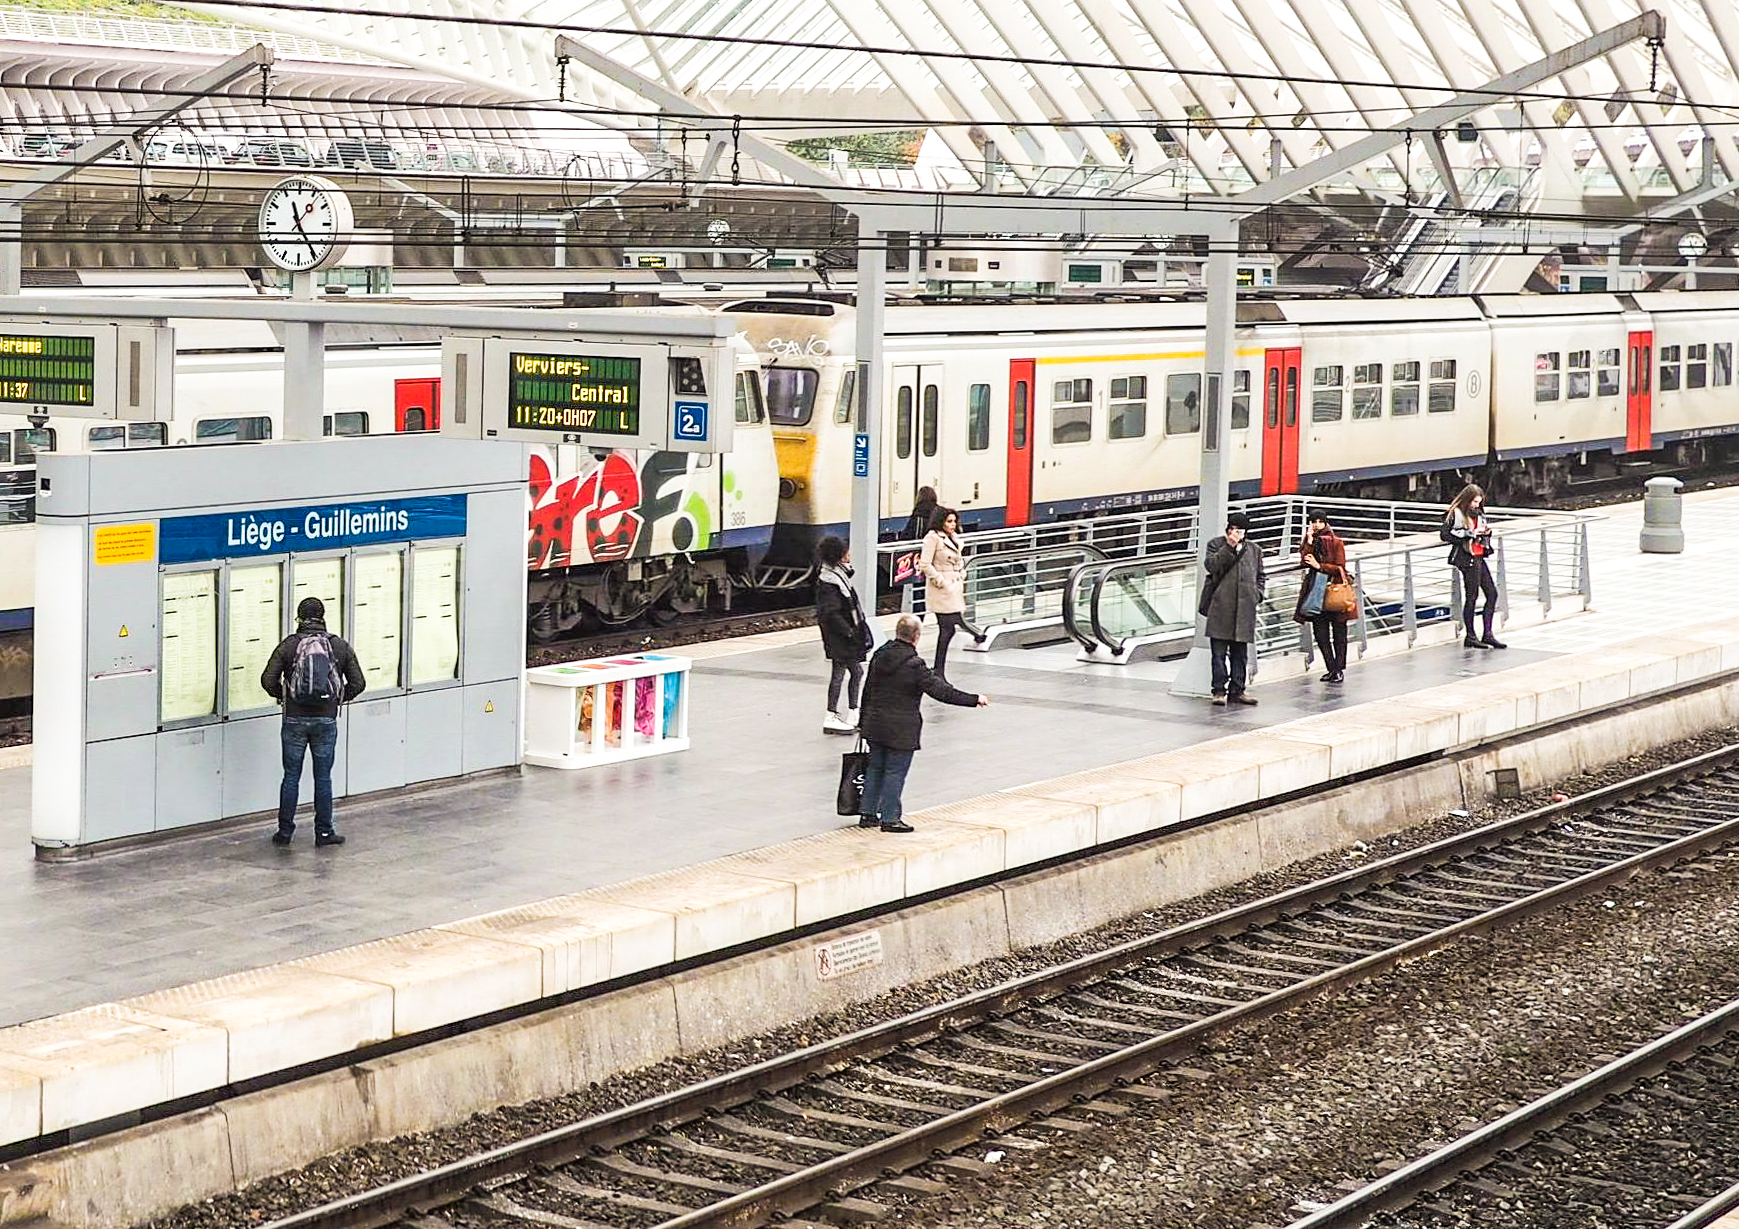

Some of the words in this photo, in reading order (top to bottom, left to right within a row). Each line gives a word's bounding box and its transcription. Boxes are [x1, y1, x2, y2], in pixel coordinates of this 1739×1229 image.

[516, 355, 590, 376] Verviers-
[79, 385, 87, 401] L
[571, 383, 629, 404] Central
[619, 411, 629, 429] L
[682, 414, 700, 433] 2a
[227, 514, 285, 551] Liège
[304, 506, 409, 540] Guillemins
[730, 511, 747, 527] 386
